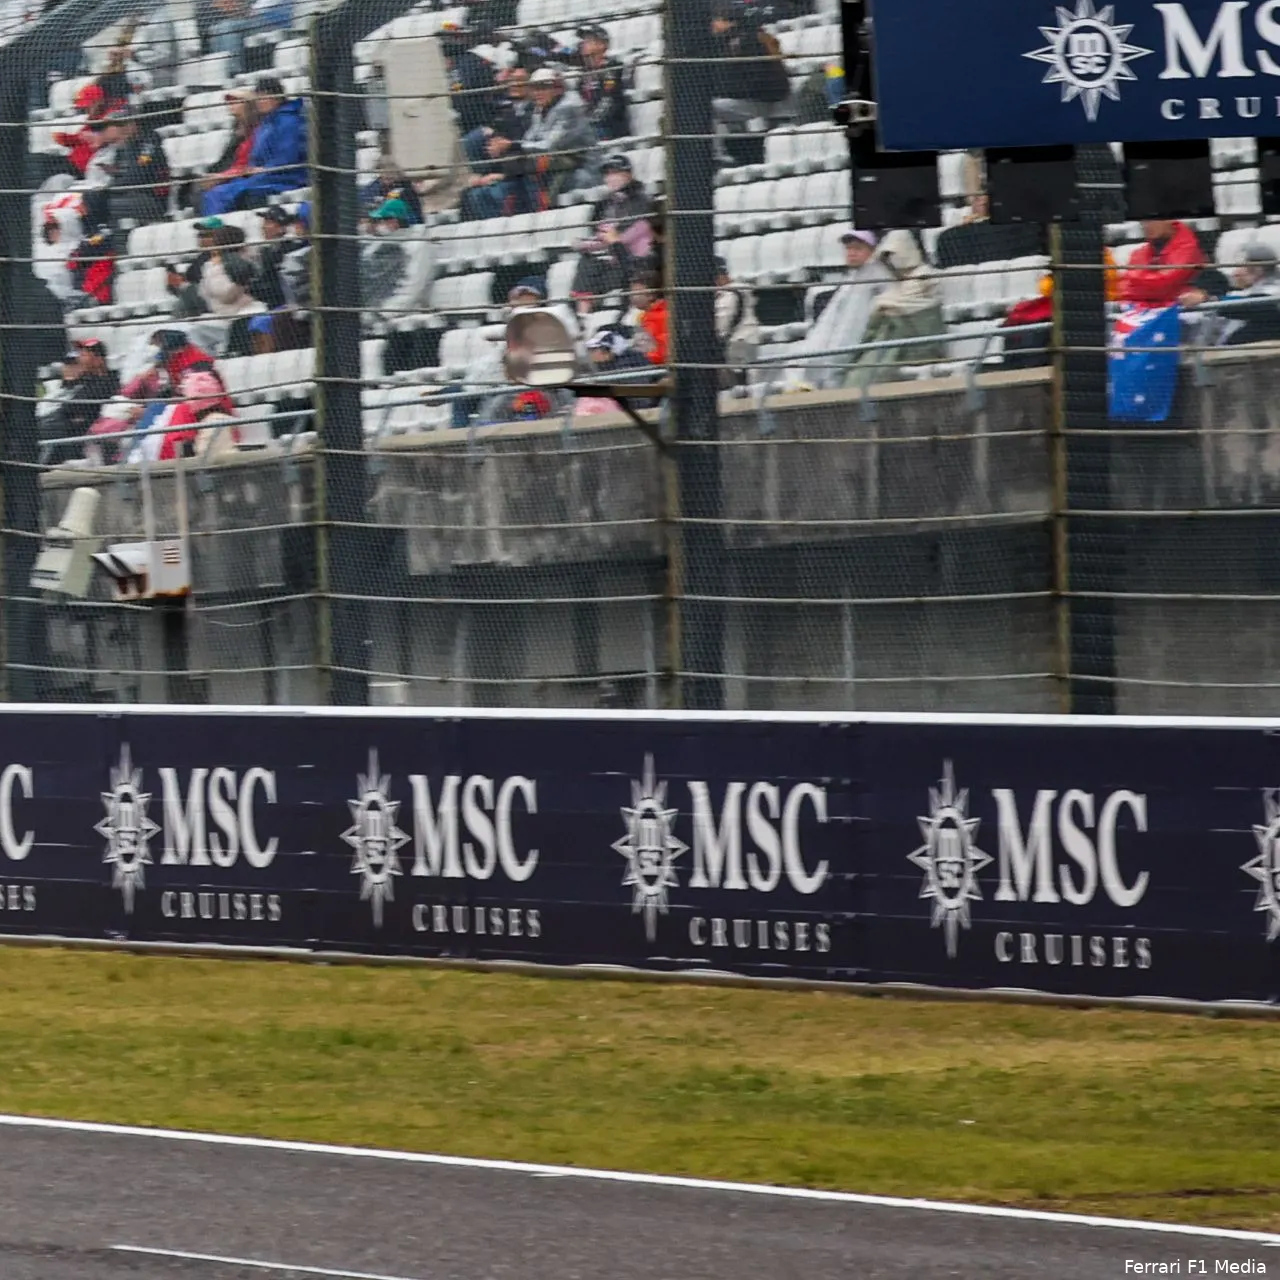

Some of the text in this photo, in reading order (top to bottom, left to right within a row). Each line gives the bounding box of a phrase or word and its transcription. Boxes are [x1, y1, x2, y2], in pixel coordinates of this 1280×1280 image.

[158, 767, 279, 868] MSC
[408, 774, 539, 882] MSC
[687, 780, 830, 894] MSC
[991, 788, 1151, 907] MSC
[161, 891, 282, 921] CRUISES
[412, 904, 541, 937] CRUISES
[689, 917, 831, 953] CRUISES
[994, 931, 1153, 968] CRUISES
